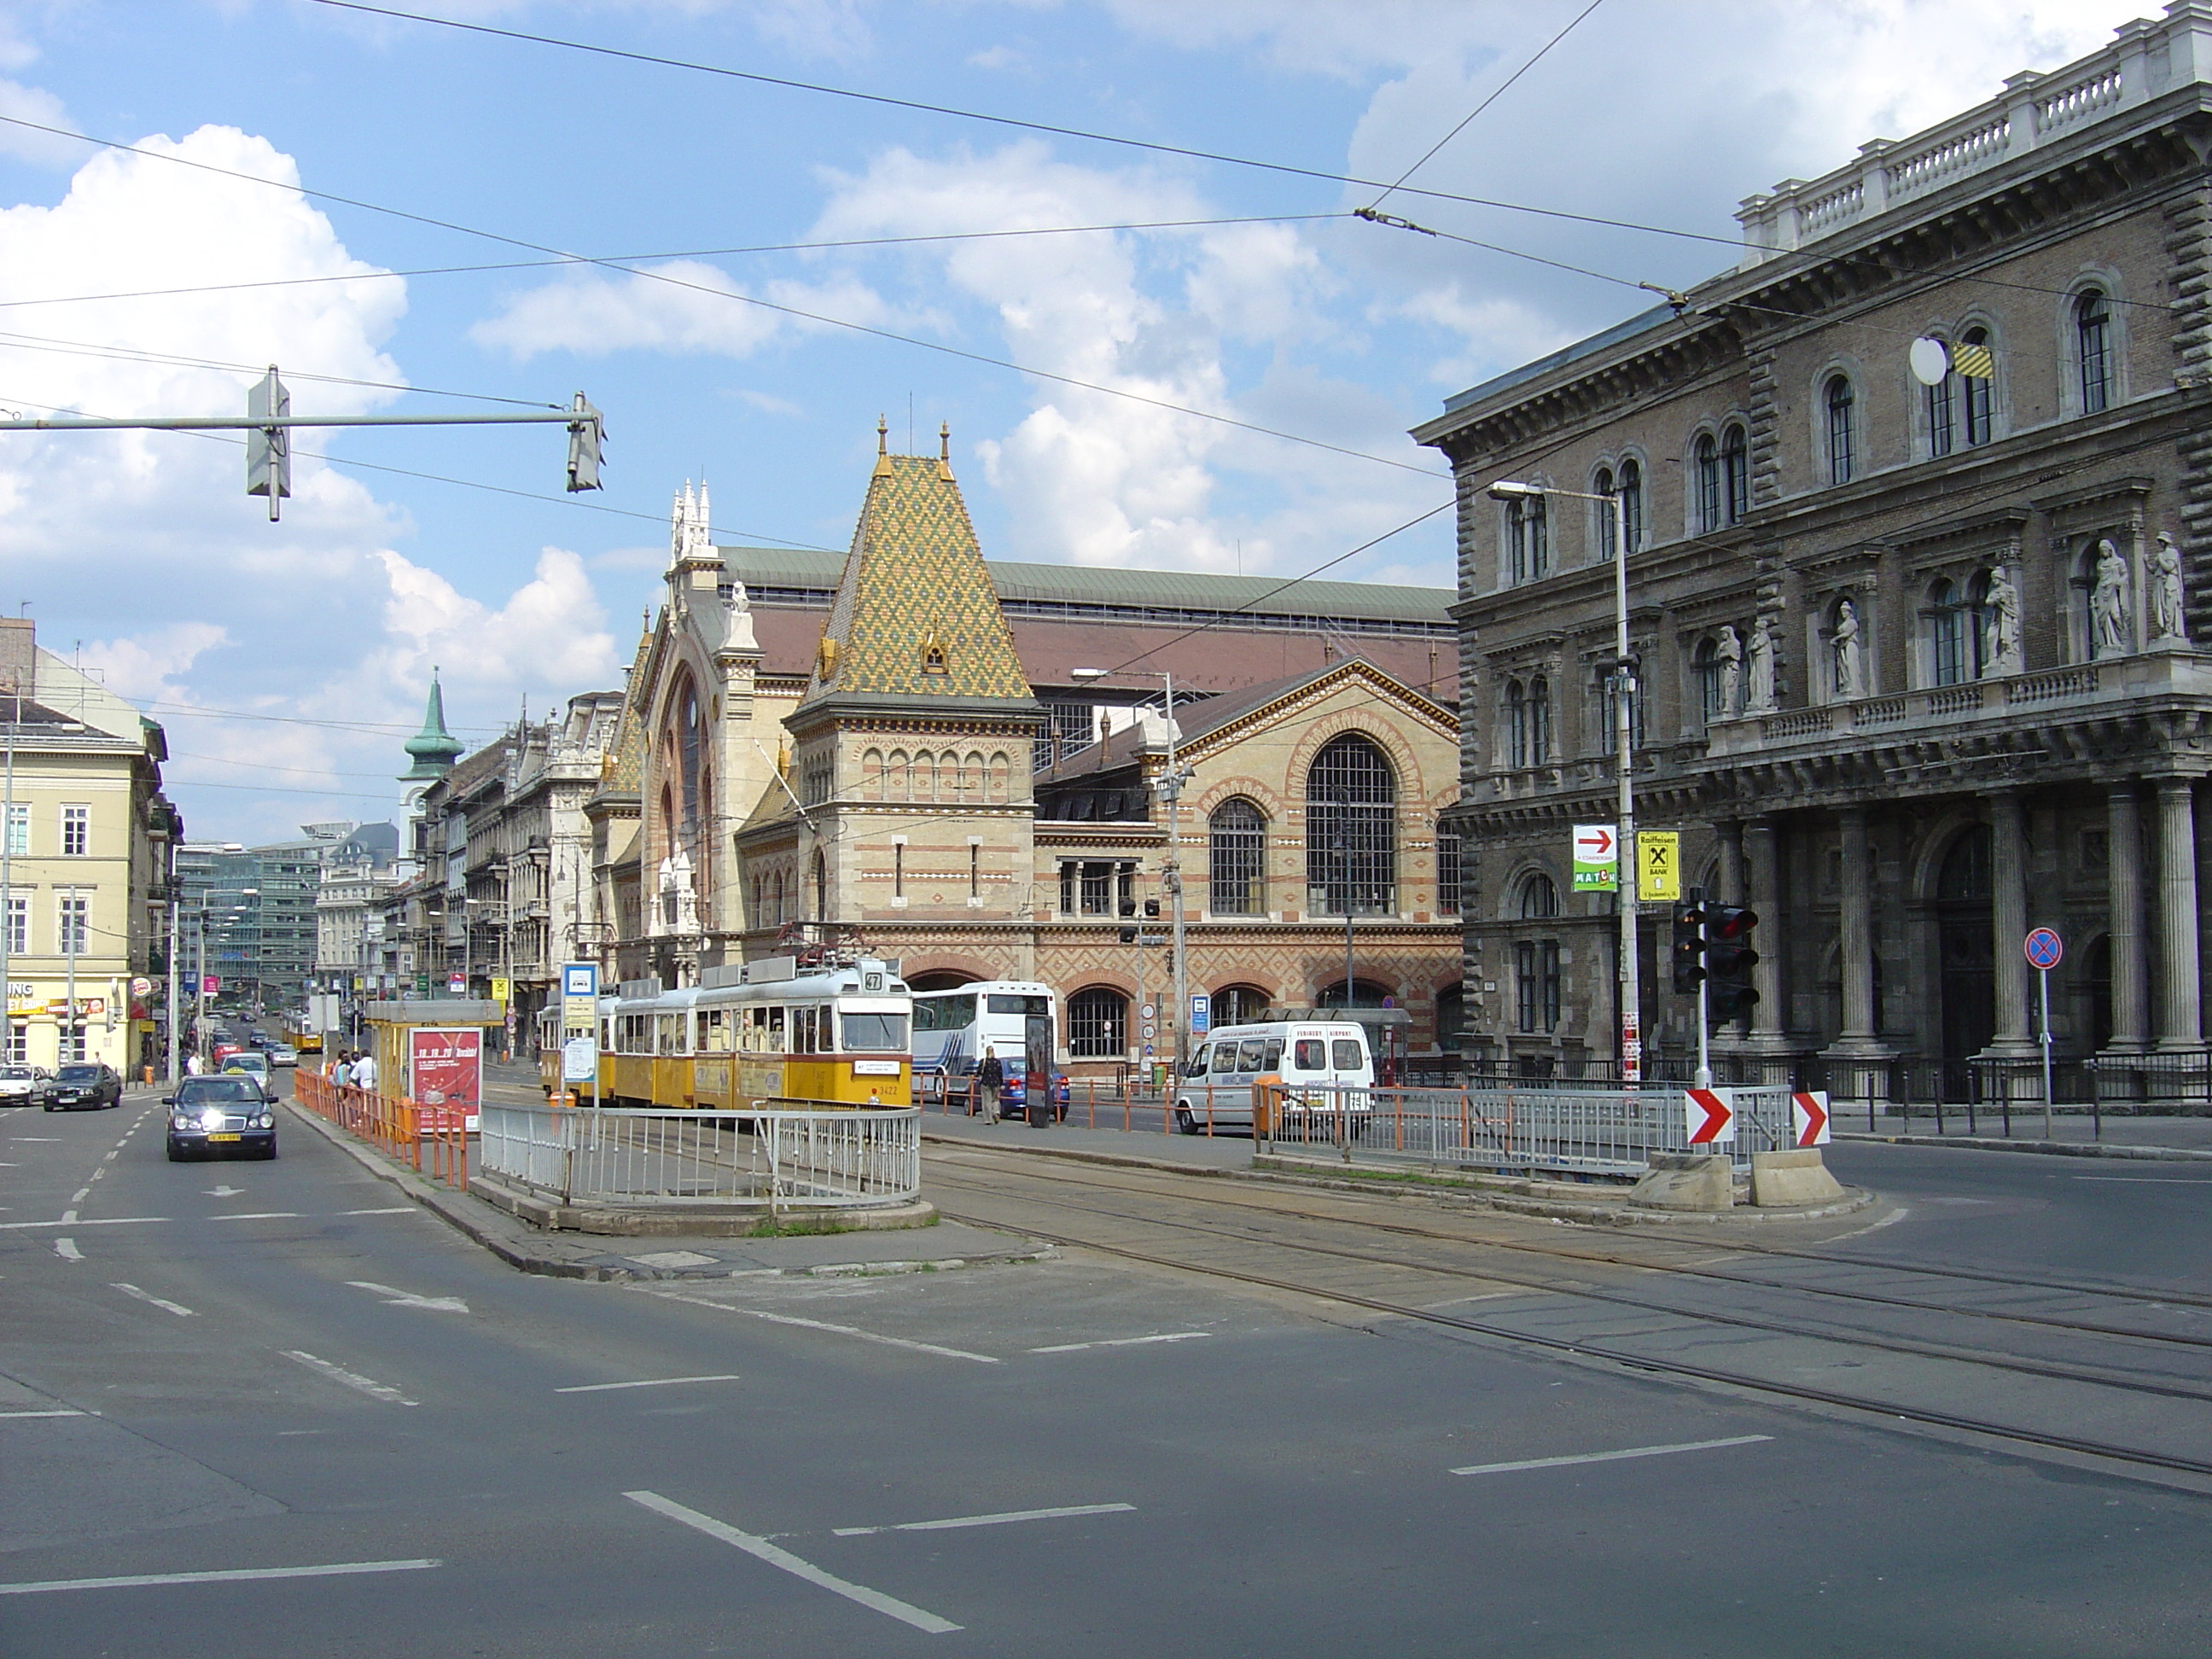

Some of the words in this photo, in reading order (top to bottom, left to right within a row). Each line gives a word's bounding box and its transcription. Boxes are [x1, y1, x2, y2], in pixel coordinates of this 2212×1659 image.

[1641, 835, 1676, 844] Raiffeisen
[1575, 870, 1615, 882] MATCH
[866, 975, 878, 988] 47
[8, 983, 32, 995] ING
